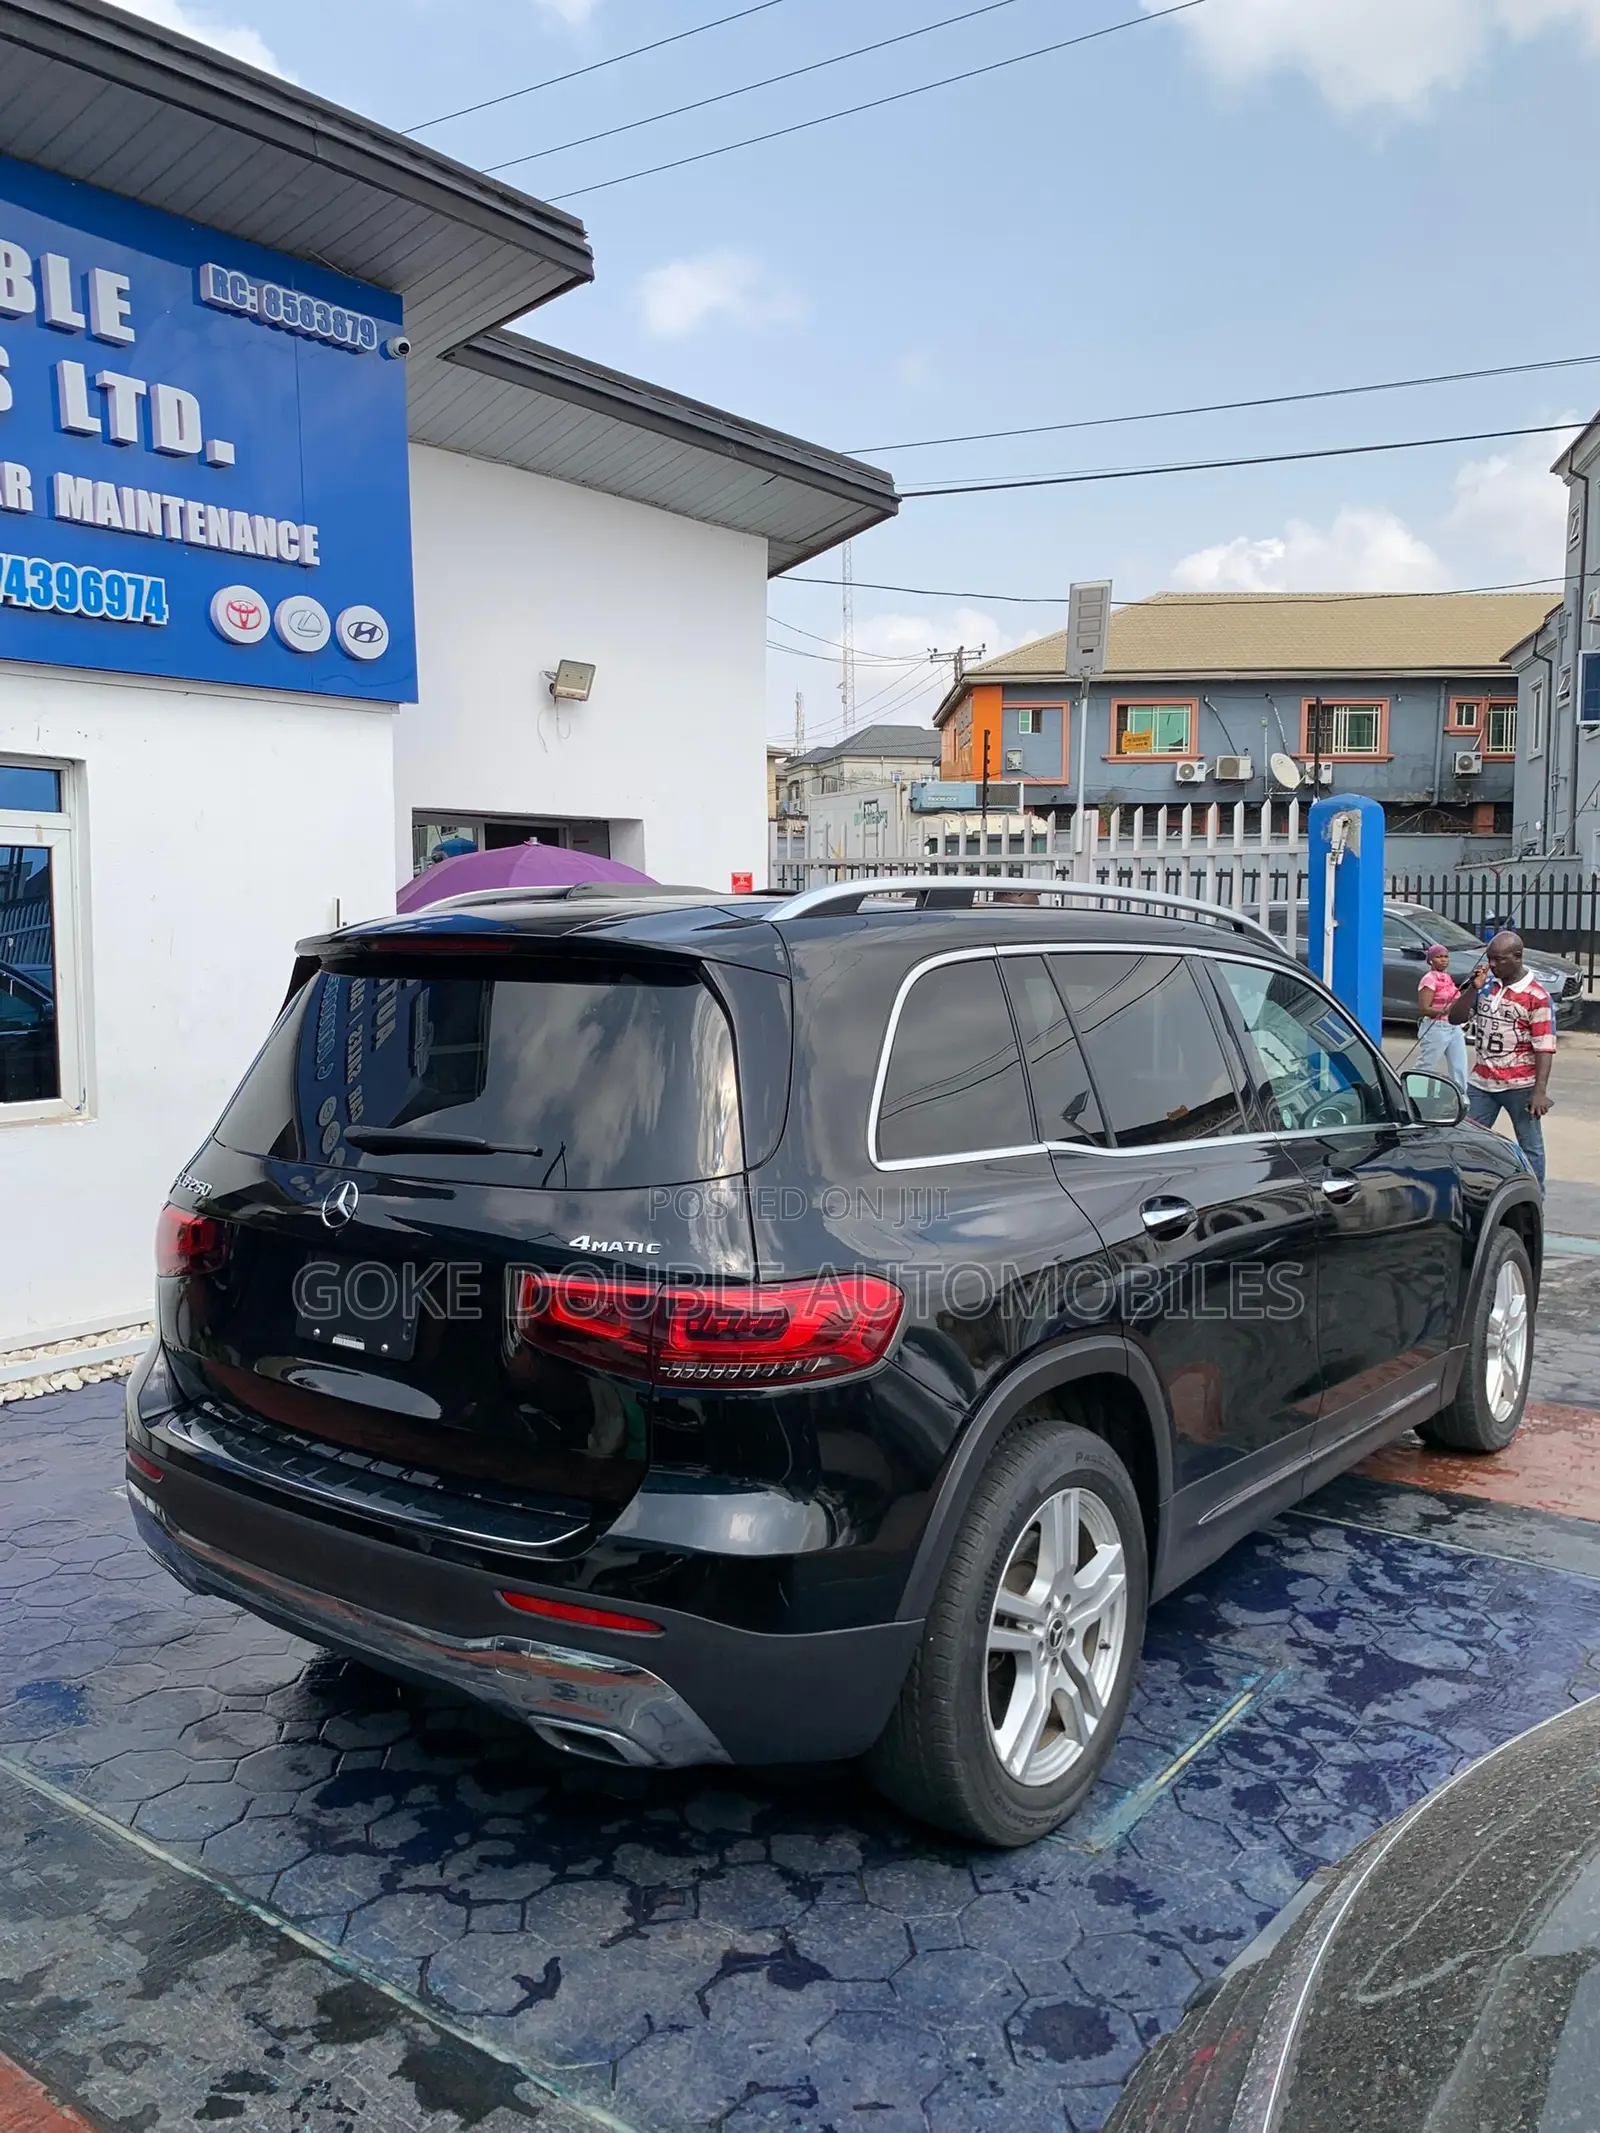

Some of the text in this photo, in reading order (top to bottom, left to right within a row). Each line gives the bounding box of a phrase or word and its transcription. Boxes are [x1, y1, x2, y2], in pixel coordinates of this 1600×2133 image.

[201, 262, 377, 351] RC: 8583879
[57, 359, 235, 465] LTD.
[54, 471, 320, 567] MAINTENANCE
[0, 552, 169, 626] 4396974
[568, 1234, 663, 1255] 4MATIC
